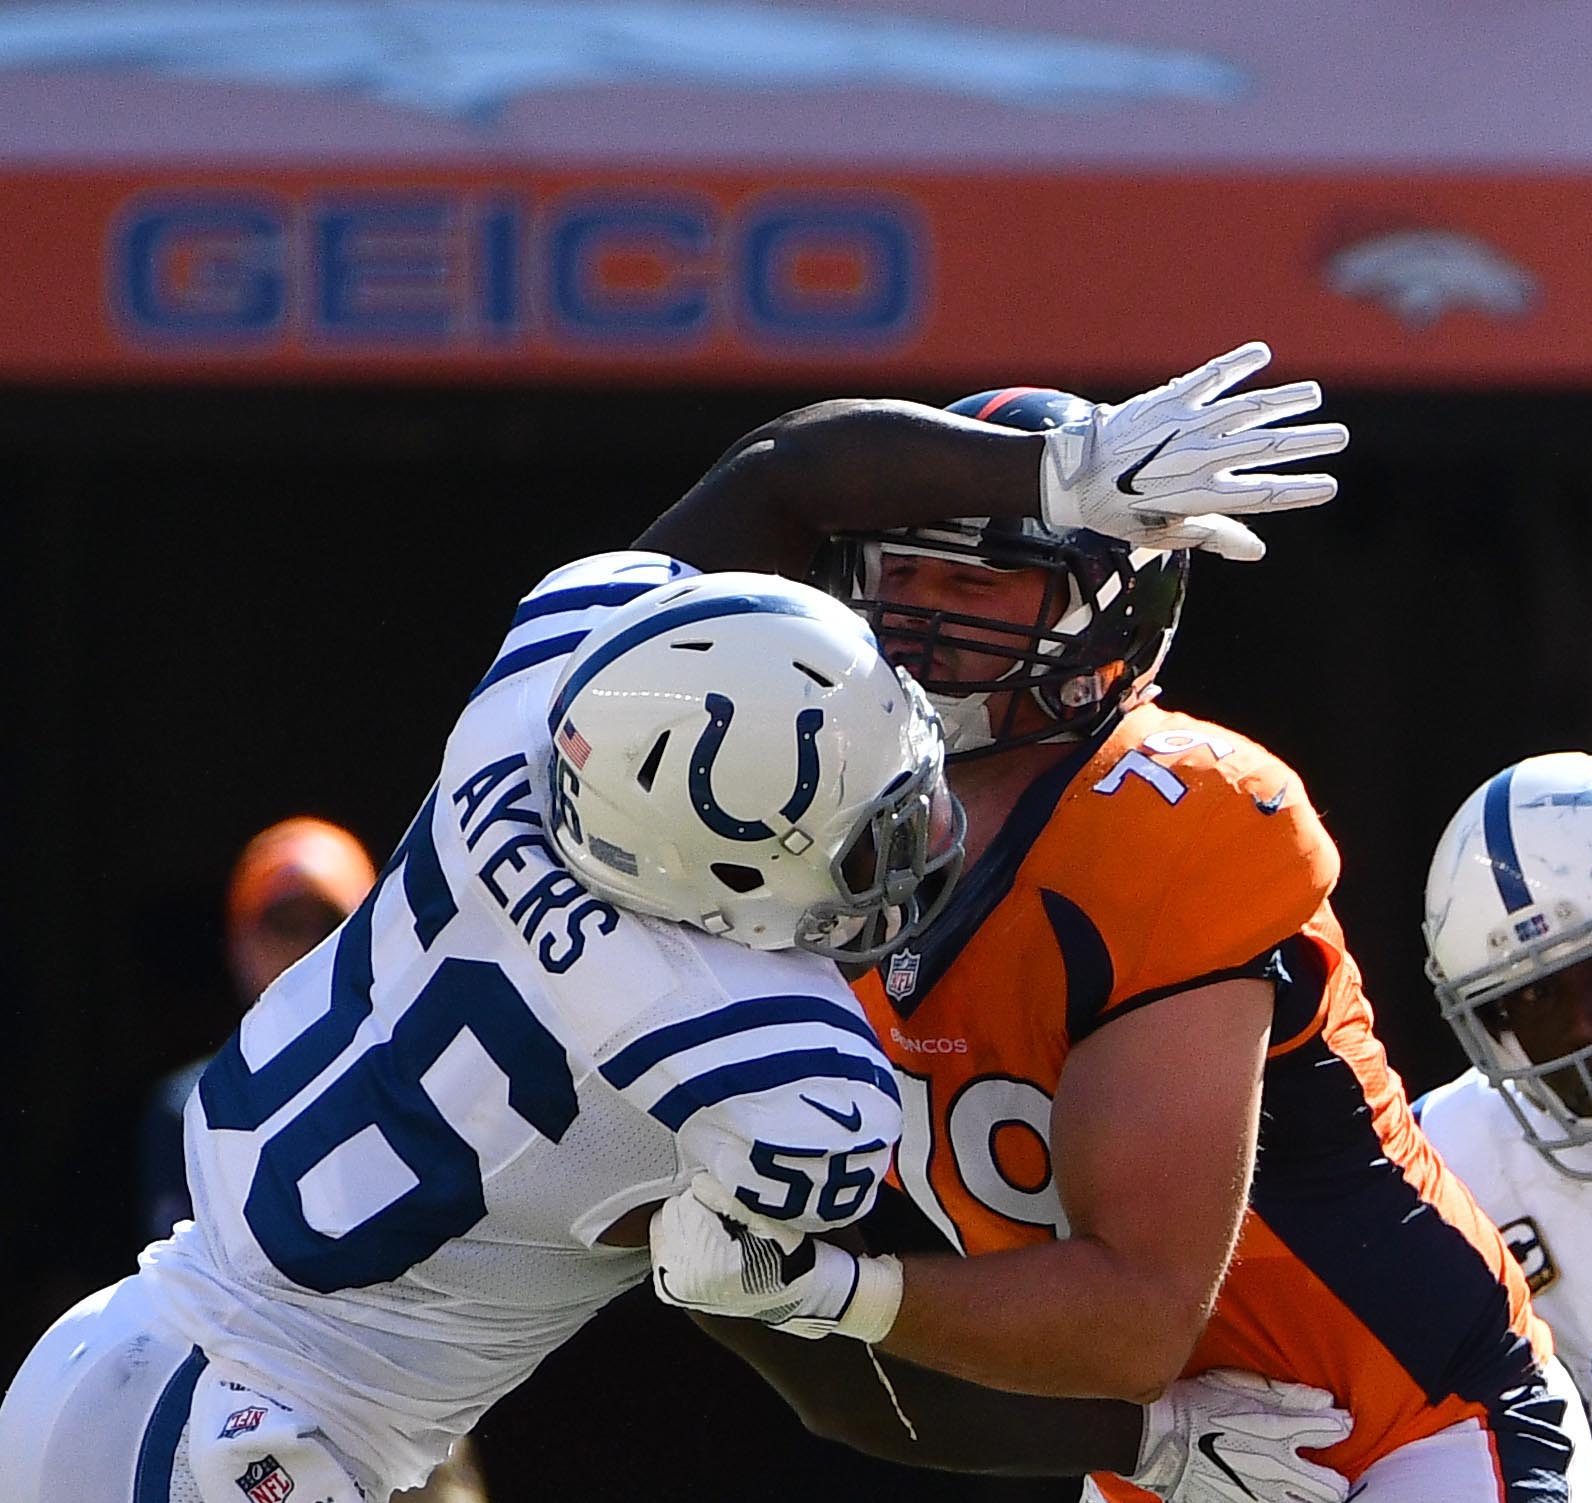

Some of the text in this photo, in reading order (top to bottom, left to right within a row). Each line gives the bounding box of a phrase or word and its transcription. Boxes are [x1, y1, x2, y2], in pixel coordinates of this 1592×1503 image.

[104, 186, 930, 356] GEICO
[1092, 729, 1236, 807] 79
[451, 752, 620, 974] AYERS
[735, 1137, 888, 1222] 56
